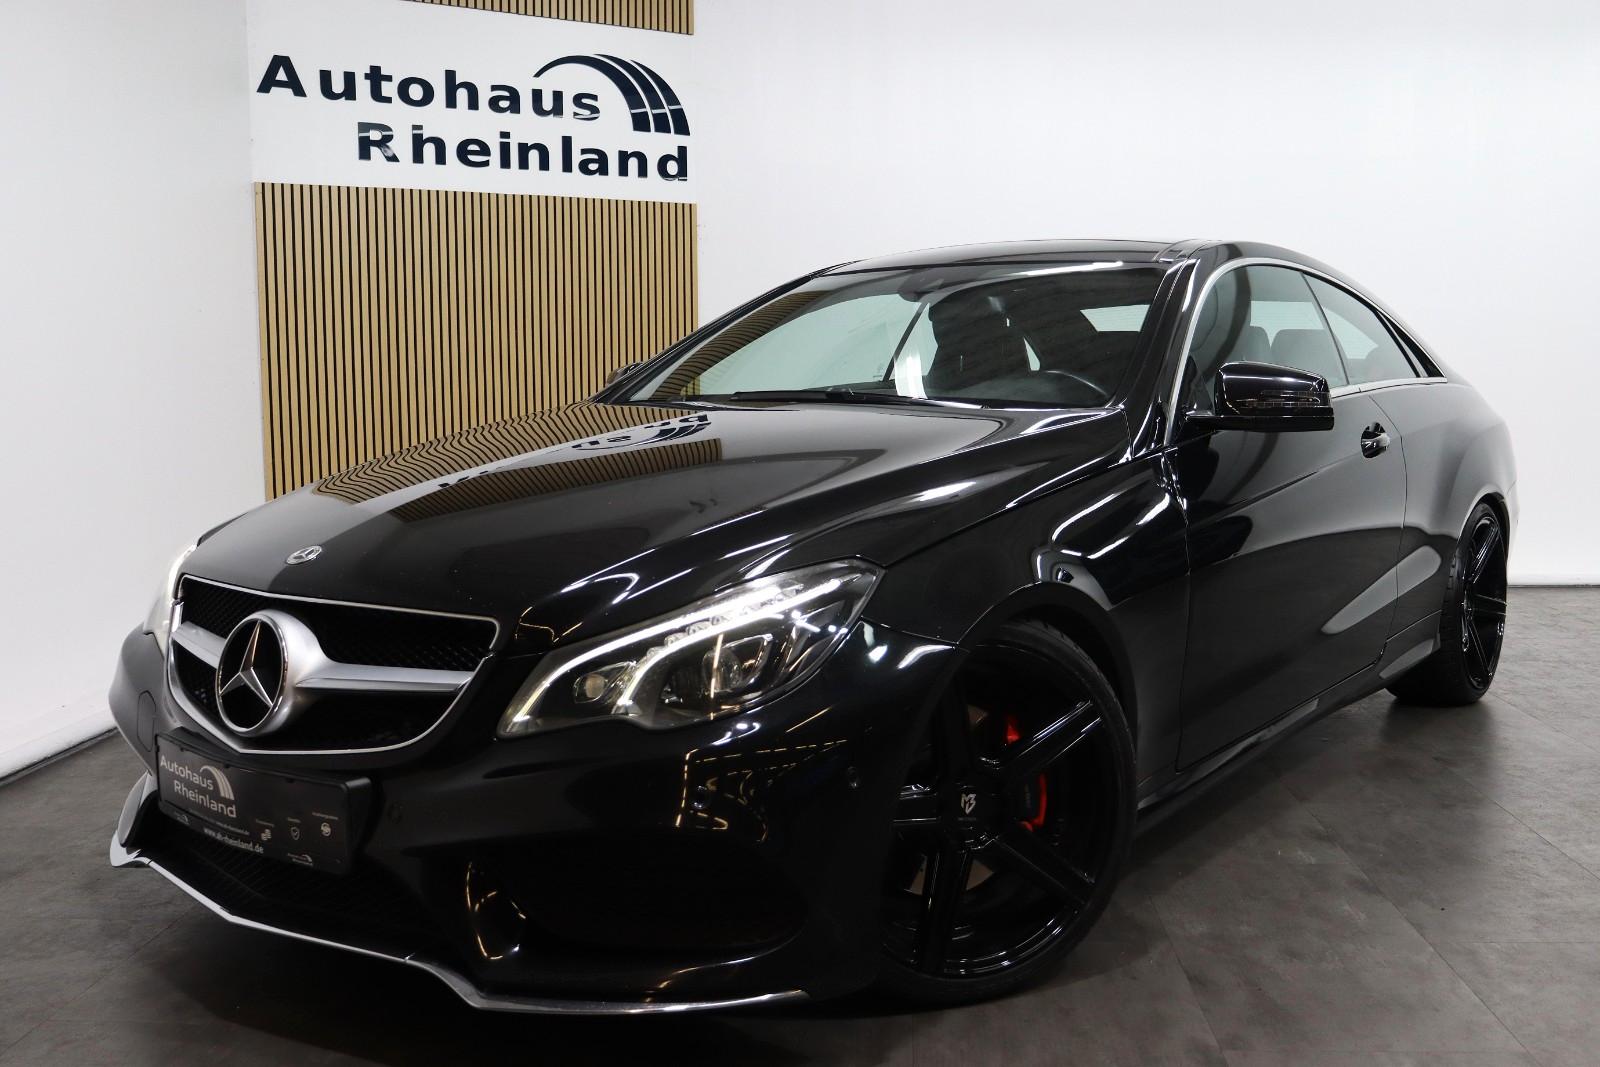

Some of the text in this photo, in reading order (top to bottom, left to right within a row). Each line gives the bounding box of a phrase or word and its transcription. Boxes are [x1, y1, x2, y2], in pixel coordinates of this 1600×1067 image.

[256, 54, 601, 121] Autohaus
[357, 121, 688, 181] Rheinland
[160, 755, 214, 791] Autohaus
[173, 780, 237, 818] Rheinland
